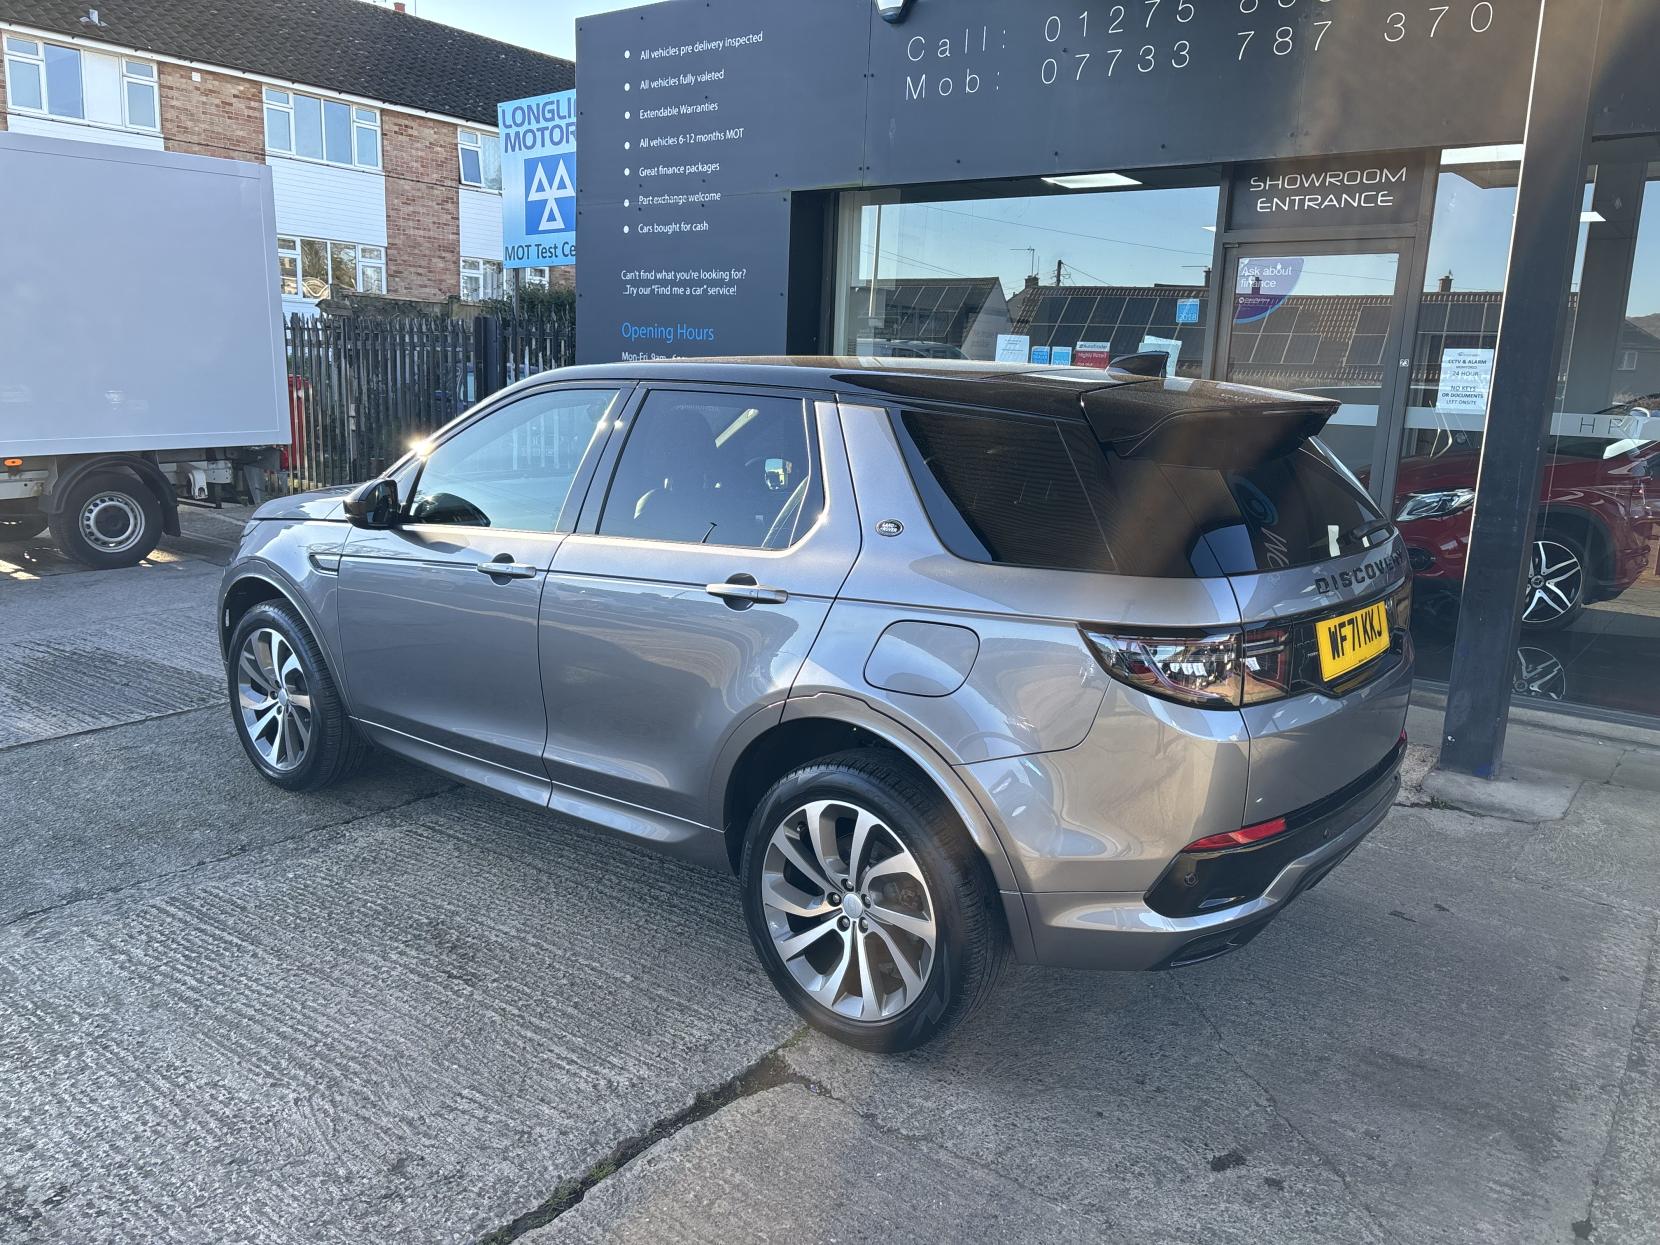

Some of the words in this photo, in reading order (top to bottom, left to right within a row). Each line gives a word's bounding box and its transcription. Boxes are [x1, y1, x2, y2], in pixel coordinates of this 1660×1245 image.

[907, 26, 1006, 61] Call:
[1044, 0, 1195, 42] 01275
[640, 50, 650, 60] All
[650, 46, 679, 58] vehicles
[680, 44, 692, 56] pre
[694, 40, 724, 52] delivery
[724, 30, 763, 48] inspected
[906, 68, 1000, 100] Mob:
[1041, 40, 1190, 84] 07733
[1238, 20, 1332, 60] 787
[1384, 2, 1493, 42] 370
[640, 80, 650, 90] All
[650, 76, 679, 88] vehicles
[680, 73, 696, 86] fully
[696, 68, 724, 82] valeted
[502, 96, 576, 129] LONGLI
[640, 106, 678, 120] Extendable
[680, 102, 718, 114] Warranties
[640, 138, 648, 148] All
[650, 136, 678, 147] vehicles
[679, 134, 695, 144] 6-12
[696, 131, 724, 142] months
[725, 128, 744, 140] MOT
[639, 167, 658, 176] Great
[659, 165, 684, 175] finance
[686, 162, 720, 175] packages
[1250, 166, 1407, 191] SHOWROOM
[639, 195, 652, 204] Part
[654, 194, 687, 205] exchange
[688, 192, 721, 202] welcome
[1256, 191, 1394, 212] ENTRANCE
[638, 223, 652, 233] Cars
[654, 222, 680, 234] bought
[681, 222, 691, 231] for
[692, 221, 709, 231] cash
[505, 244, 532, 262] MOT
[534, 243, 558, 260] Test
[621, 270, 639, 280] Can't
[640, 270, 654, 280] find
[656, 270, 675, 280] what
[676, 270, 699, 281] you're
[700, 269, 729, 281] looking
[731, 269, 747, 279] for?
[1241, 267, 1260, 276] Ask
[1262, 266, 1292, 276] about
[707, 285, 737, 295] service!
[1240, 278, 1277, 288] finance
[622, 322, 674, 344] Opening
[677, 324, 714, 341] Hours
[1314, 550, 1402, 594] DISCOVERY
[1328, 614, 1361, 660] WF71
[1362, 606, 1383, 646] KKJ
